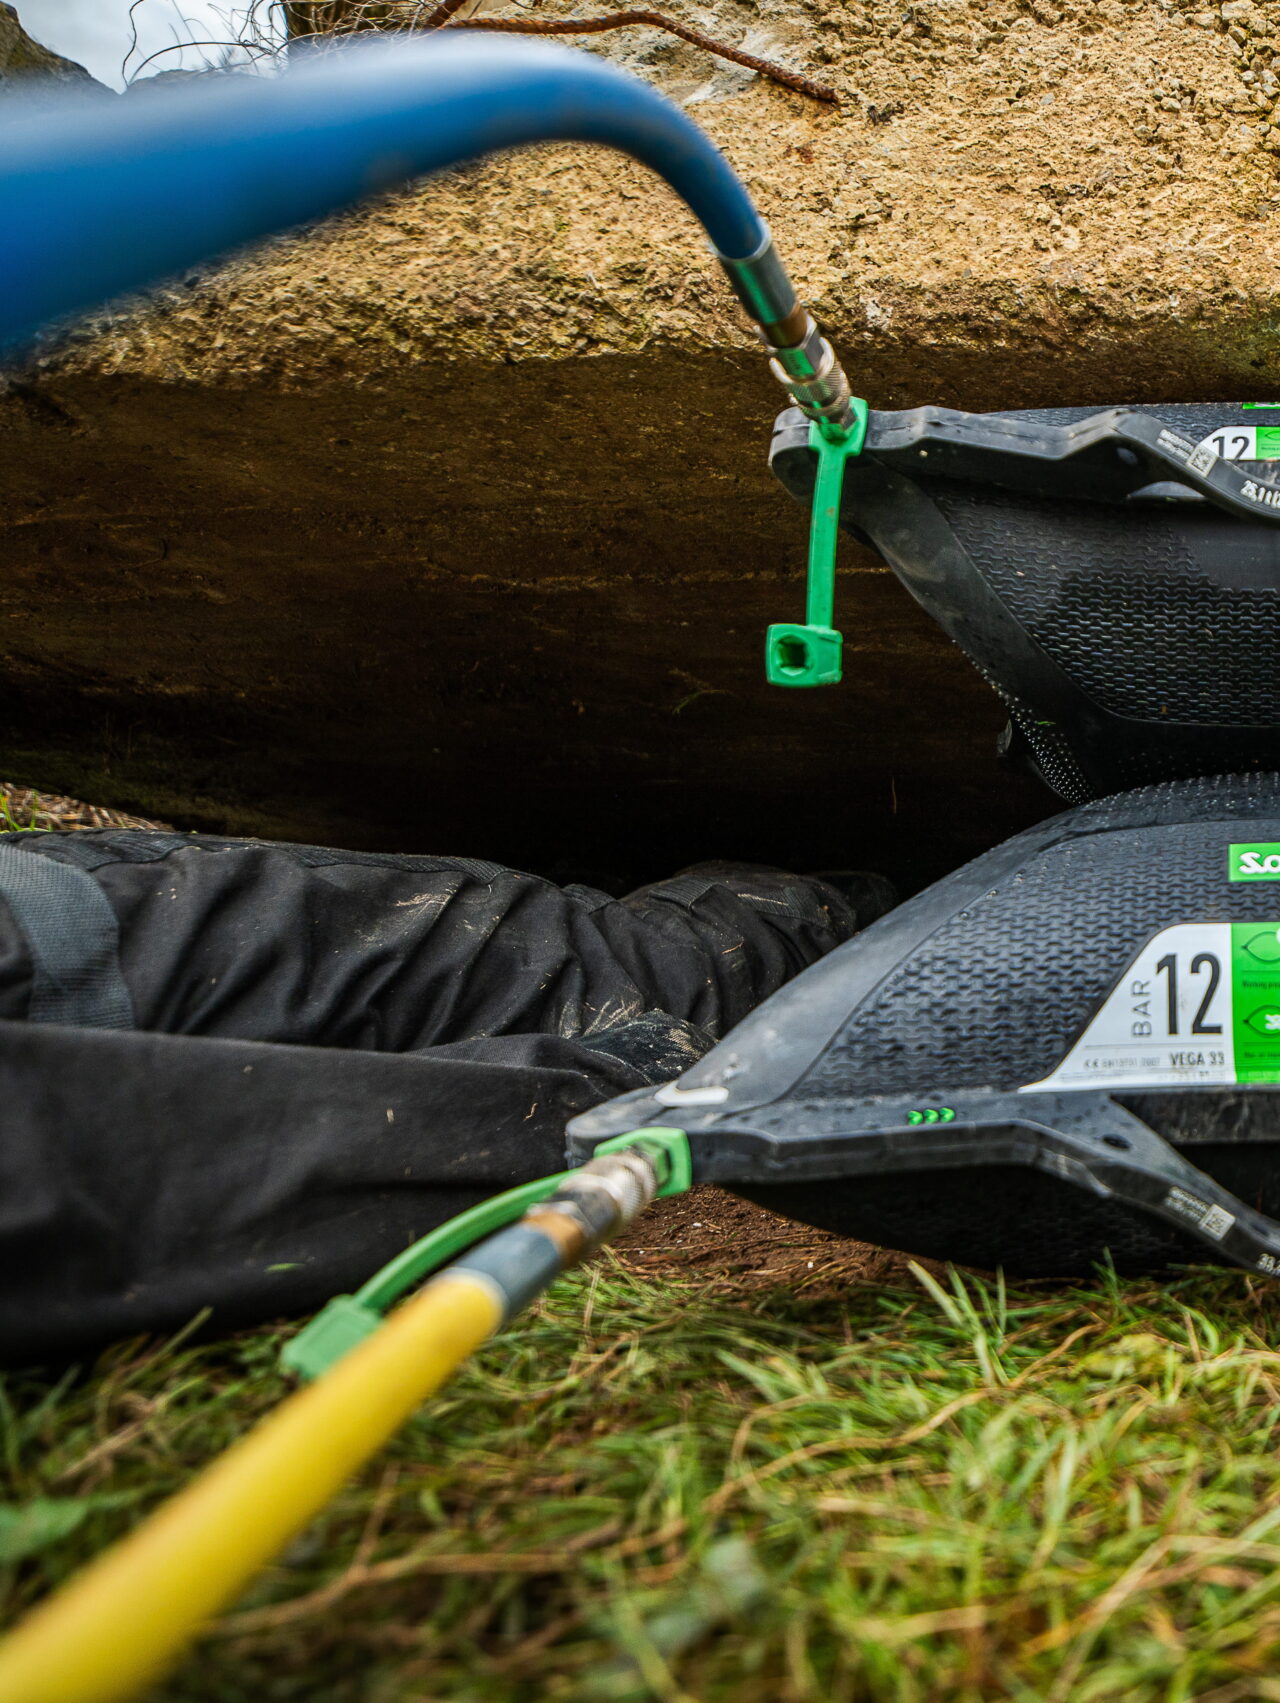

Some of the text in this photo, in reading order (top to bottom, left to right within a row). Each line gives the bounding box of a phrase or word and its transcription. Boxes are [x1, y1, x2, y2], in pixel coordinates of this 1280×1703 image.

[1212, 436, 1250, 460] 12
[1131, 979, 1151, 1037] BAR
[1156, 952, 1222, 1035] 12
[1169, 1051, 1206, 1067] VEGA
[1208, 1051, 1225, 1066] 33
